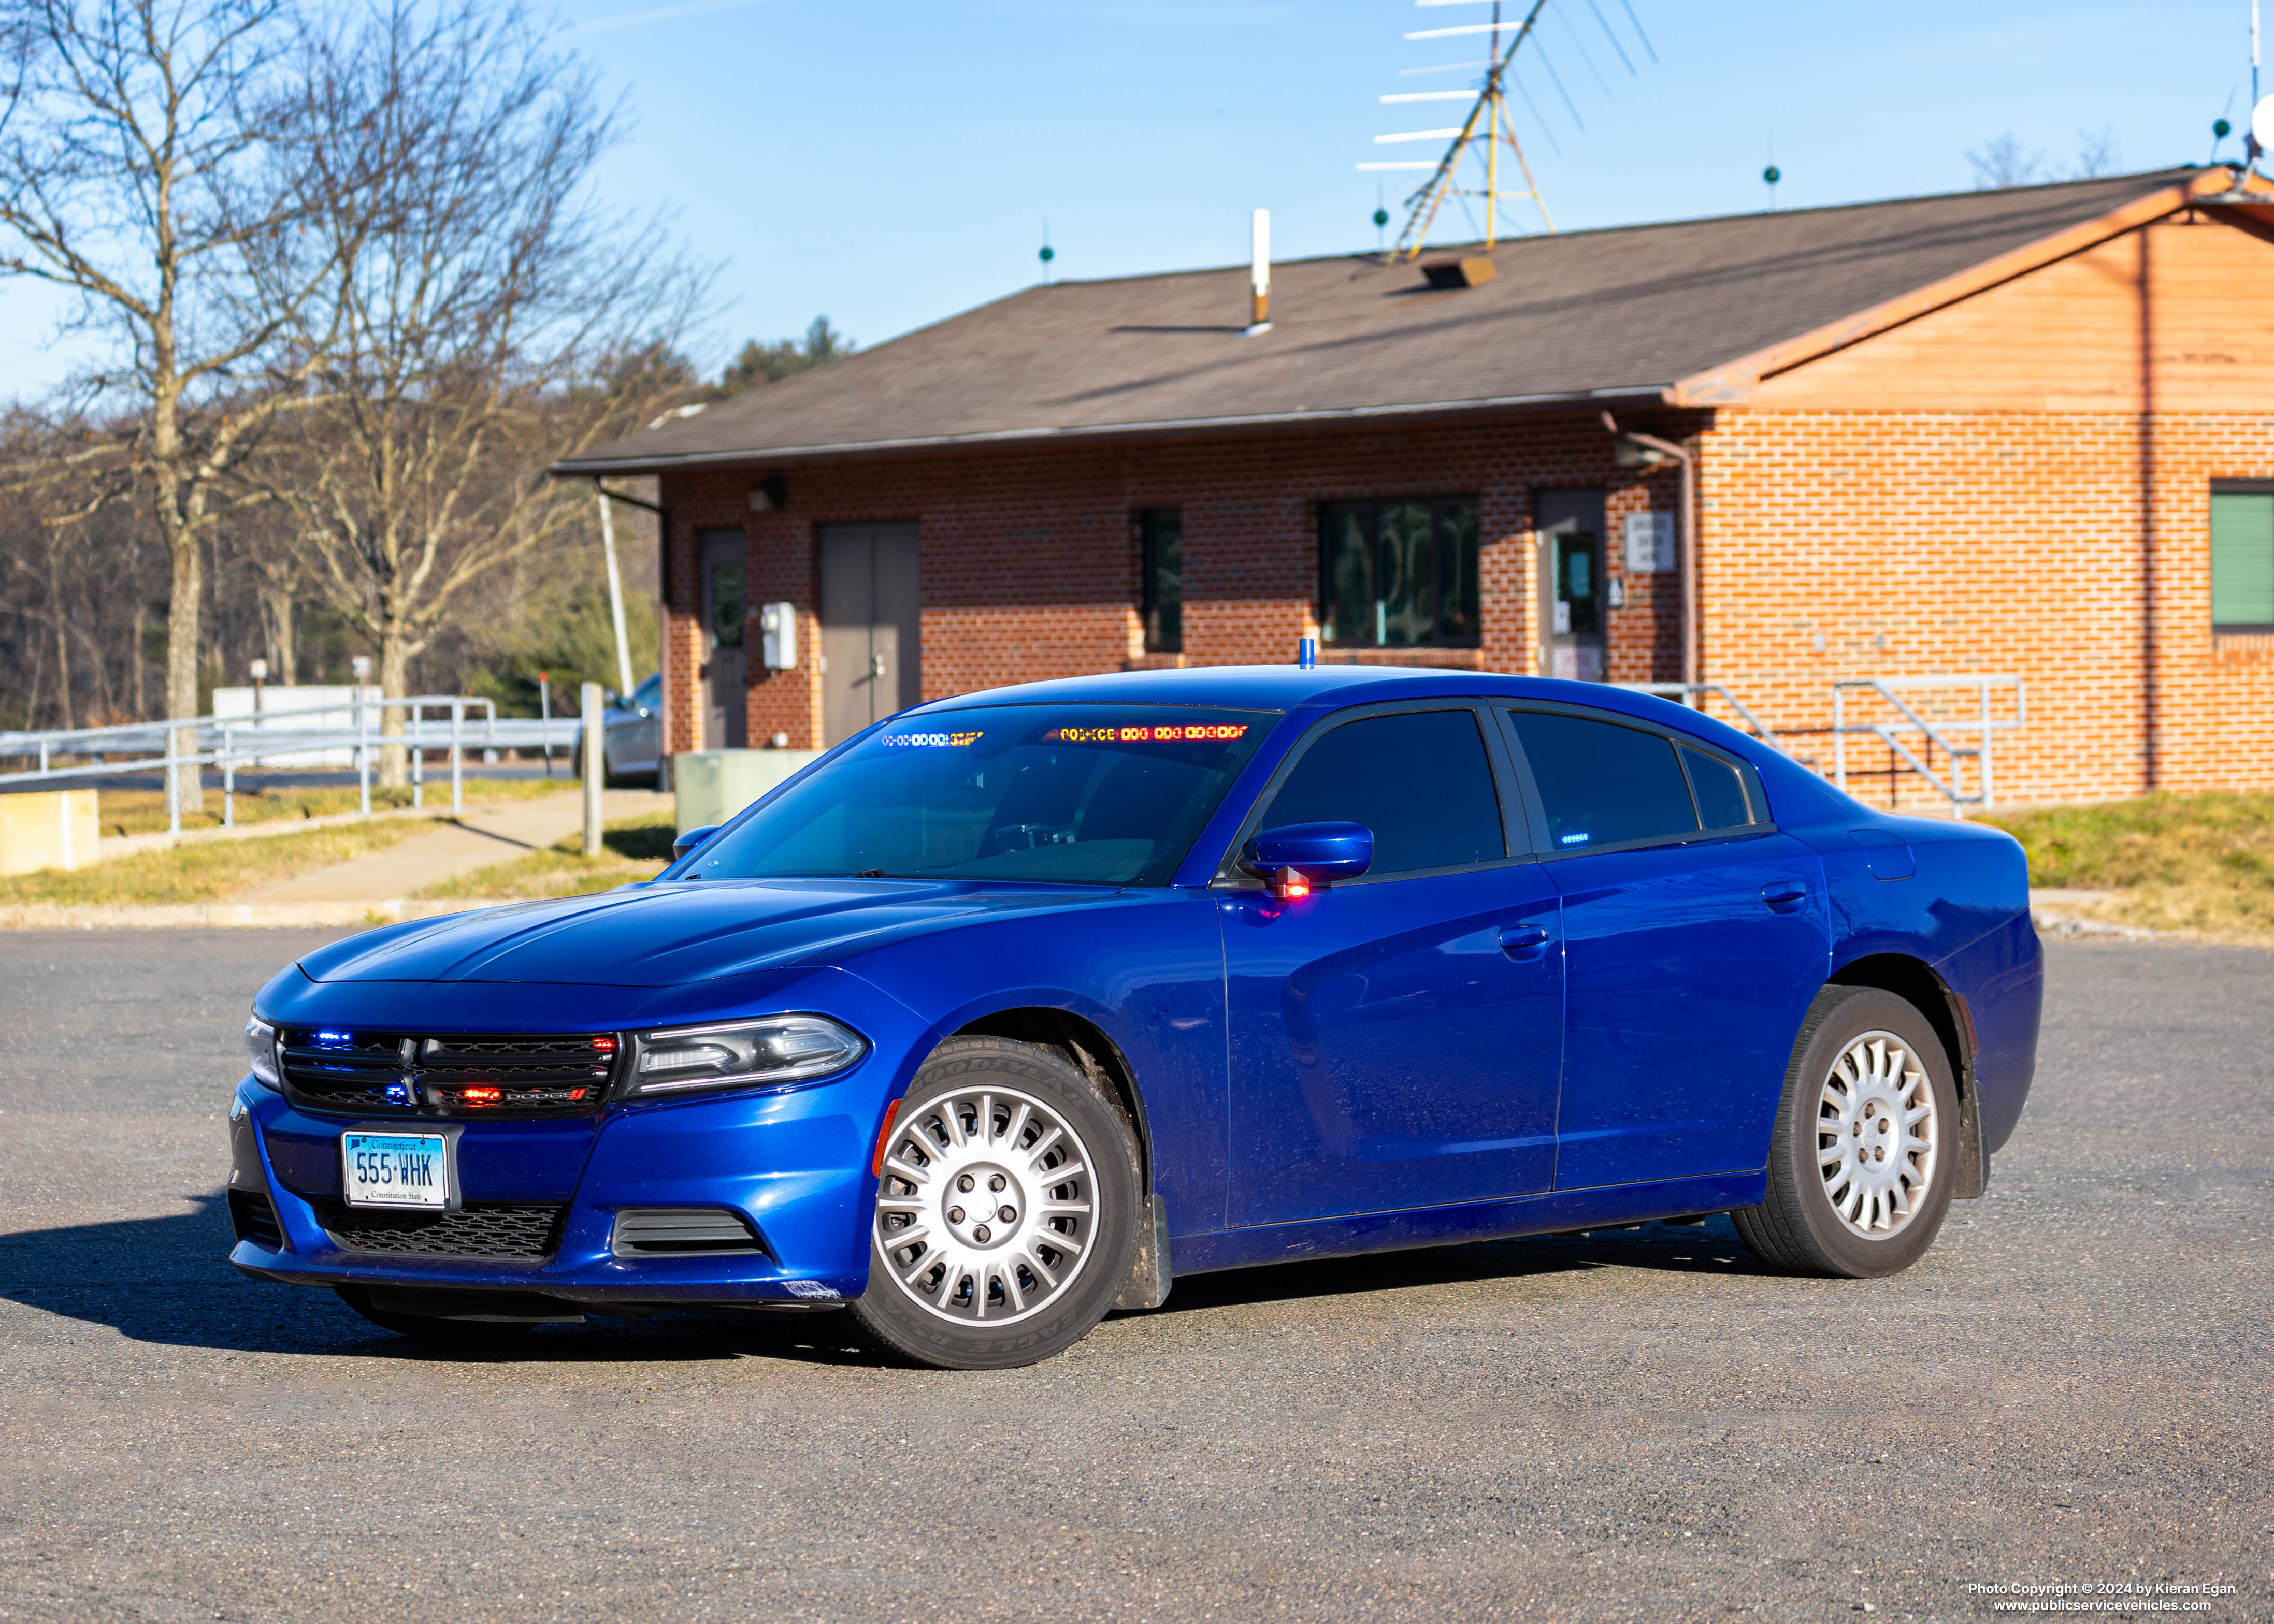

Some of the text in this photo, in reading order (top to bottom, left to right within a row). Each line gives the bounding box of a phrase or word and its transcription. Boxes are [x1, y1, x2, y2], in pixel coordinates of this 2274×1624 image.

[372, 1140, 416, 1150] Connecticut
[371, 1191, 407, 1199] Constitution
[969, 1306, 1076, 1352] EAGLE
